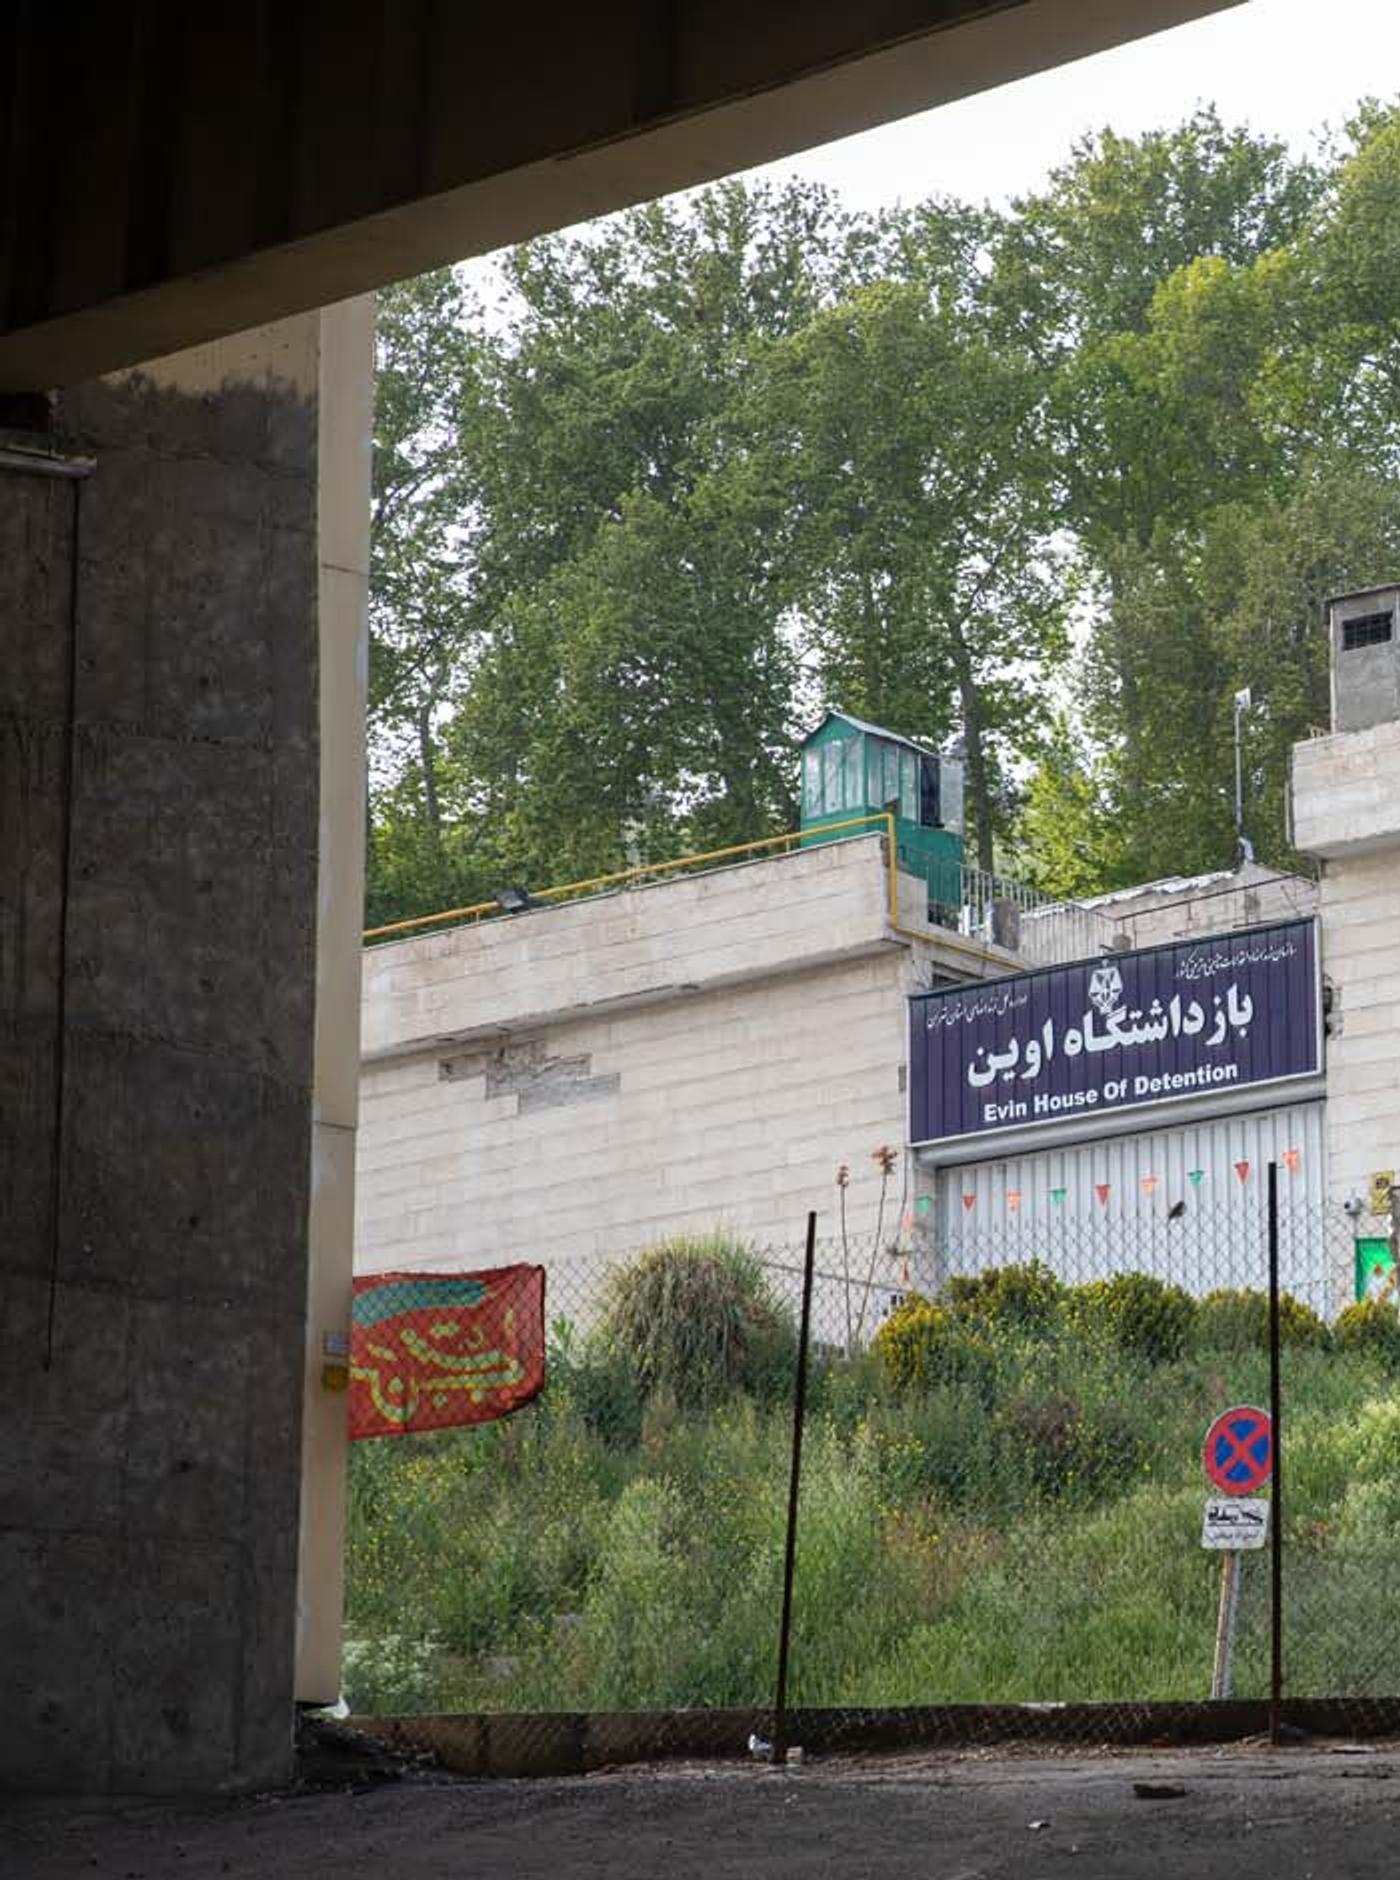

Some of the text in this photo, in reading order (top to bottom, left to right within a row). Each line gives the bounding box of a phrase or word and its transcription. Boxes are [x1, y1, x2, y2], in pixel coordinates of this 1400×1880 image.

[967, 982, 1254, 1088] بازداشتگاه اوین
[983, 1062, 1238, 1123] Evin House Of Detention
